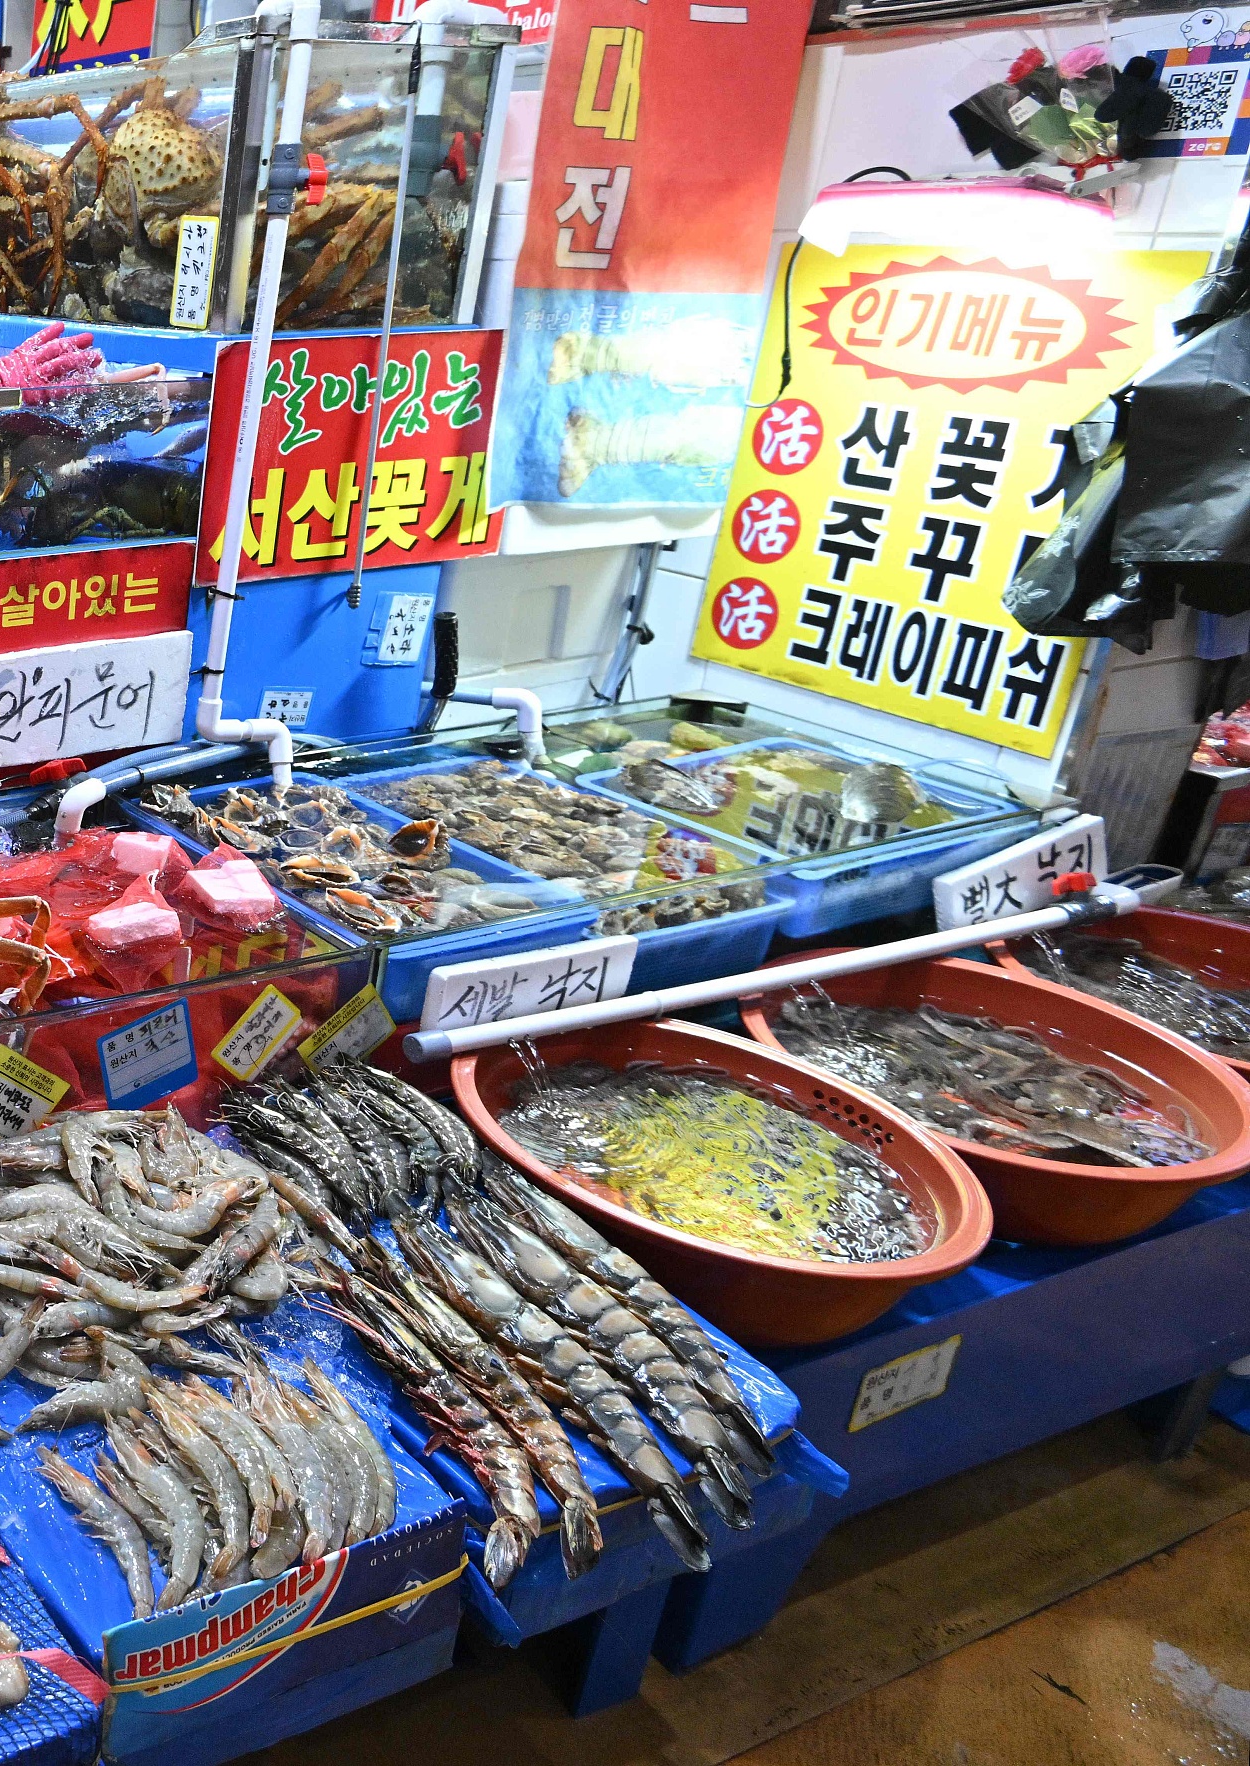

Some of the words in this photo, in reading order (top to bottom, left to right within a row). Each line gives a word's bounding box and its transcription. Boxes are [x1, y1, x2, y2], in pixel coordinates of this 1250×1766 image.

[848, 285, 1071, 363] 인기메뉴
[262, 349, 482, 454] 살아있는
[759, 405, 818, 466] 活
[210, 452, 491, 568] 서산꽃게
[738, 497, 793, 555] 活
[0, 572, 160, 629] 살아있는
[719, 585, 774, 640] 活
[790, 586, 1067, 728] 크레이피쉬
[1038, 834, 1092, 882] 낙지
[439, 970, 528, 1024] 세발
[538, 956, 609, 1010] 낙지
[110, 1049, 138, 1069] 원산지
[222, 1033, 245, 1058] 원산지
[370, 1504, 454, 1547] NACIONAL
[370, 1527, 453, 1568] SOCIEDAD
[116, 1559, 326, 1682] Champmar
[286, 1601, 307, 1620] FARM
